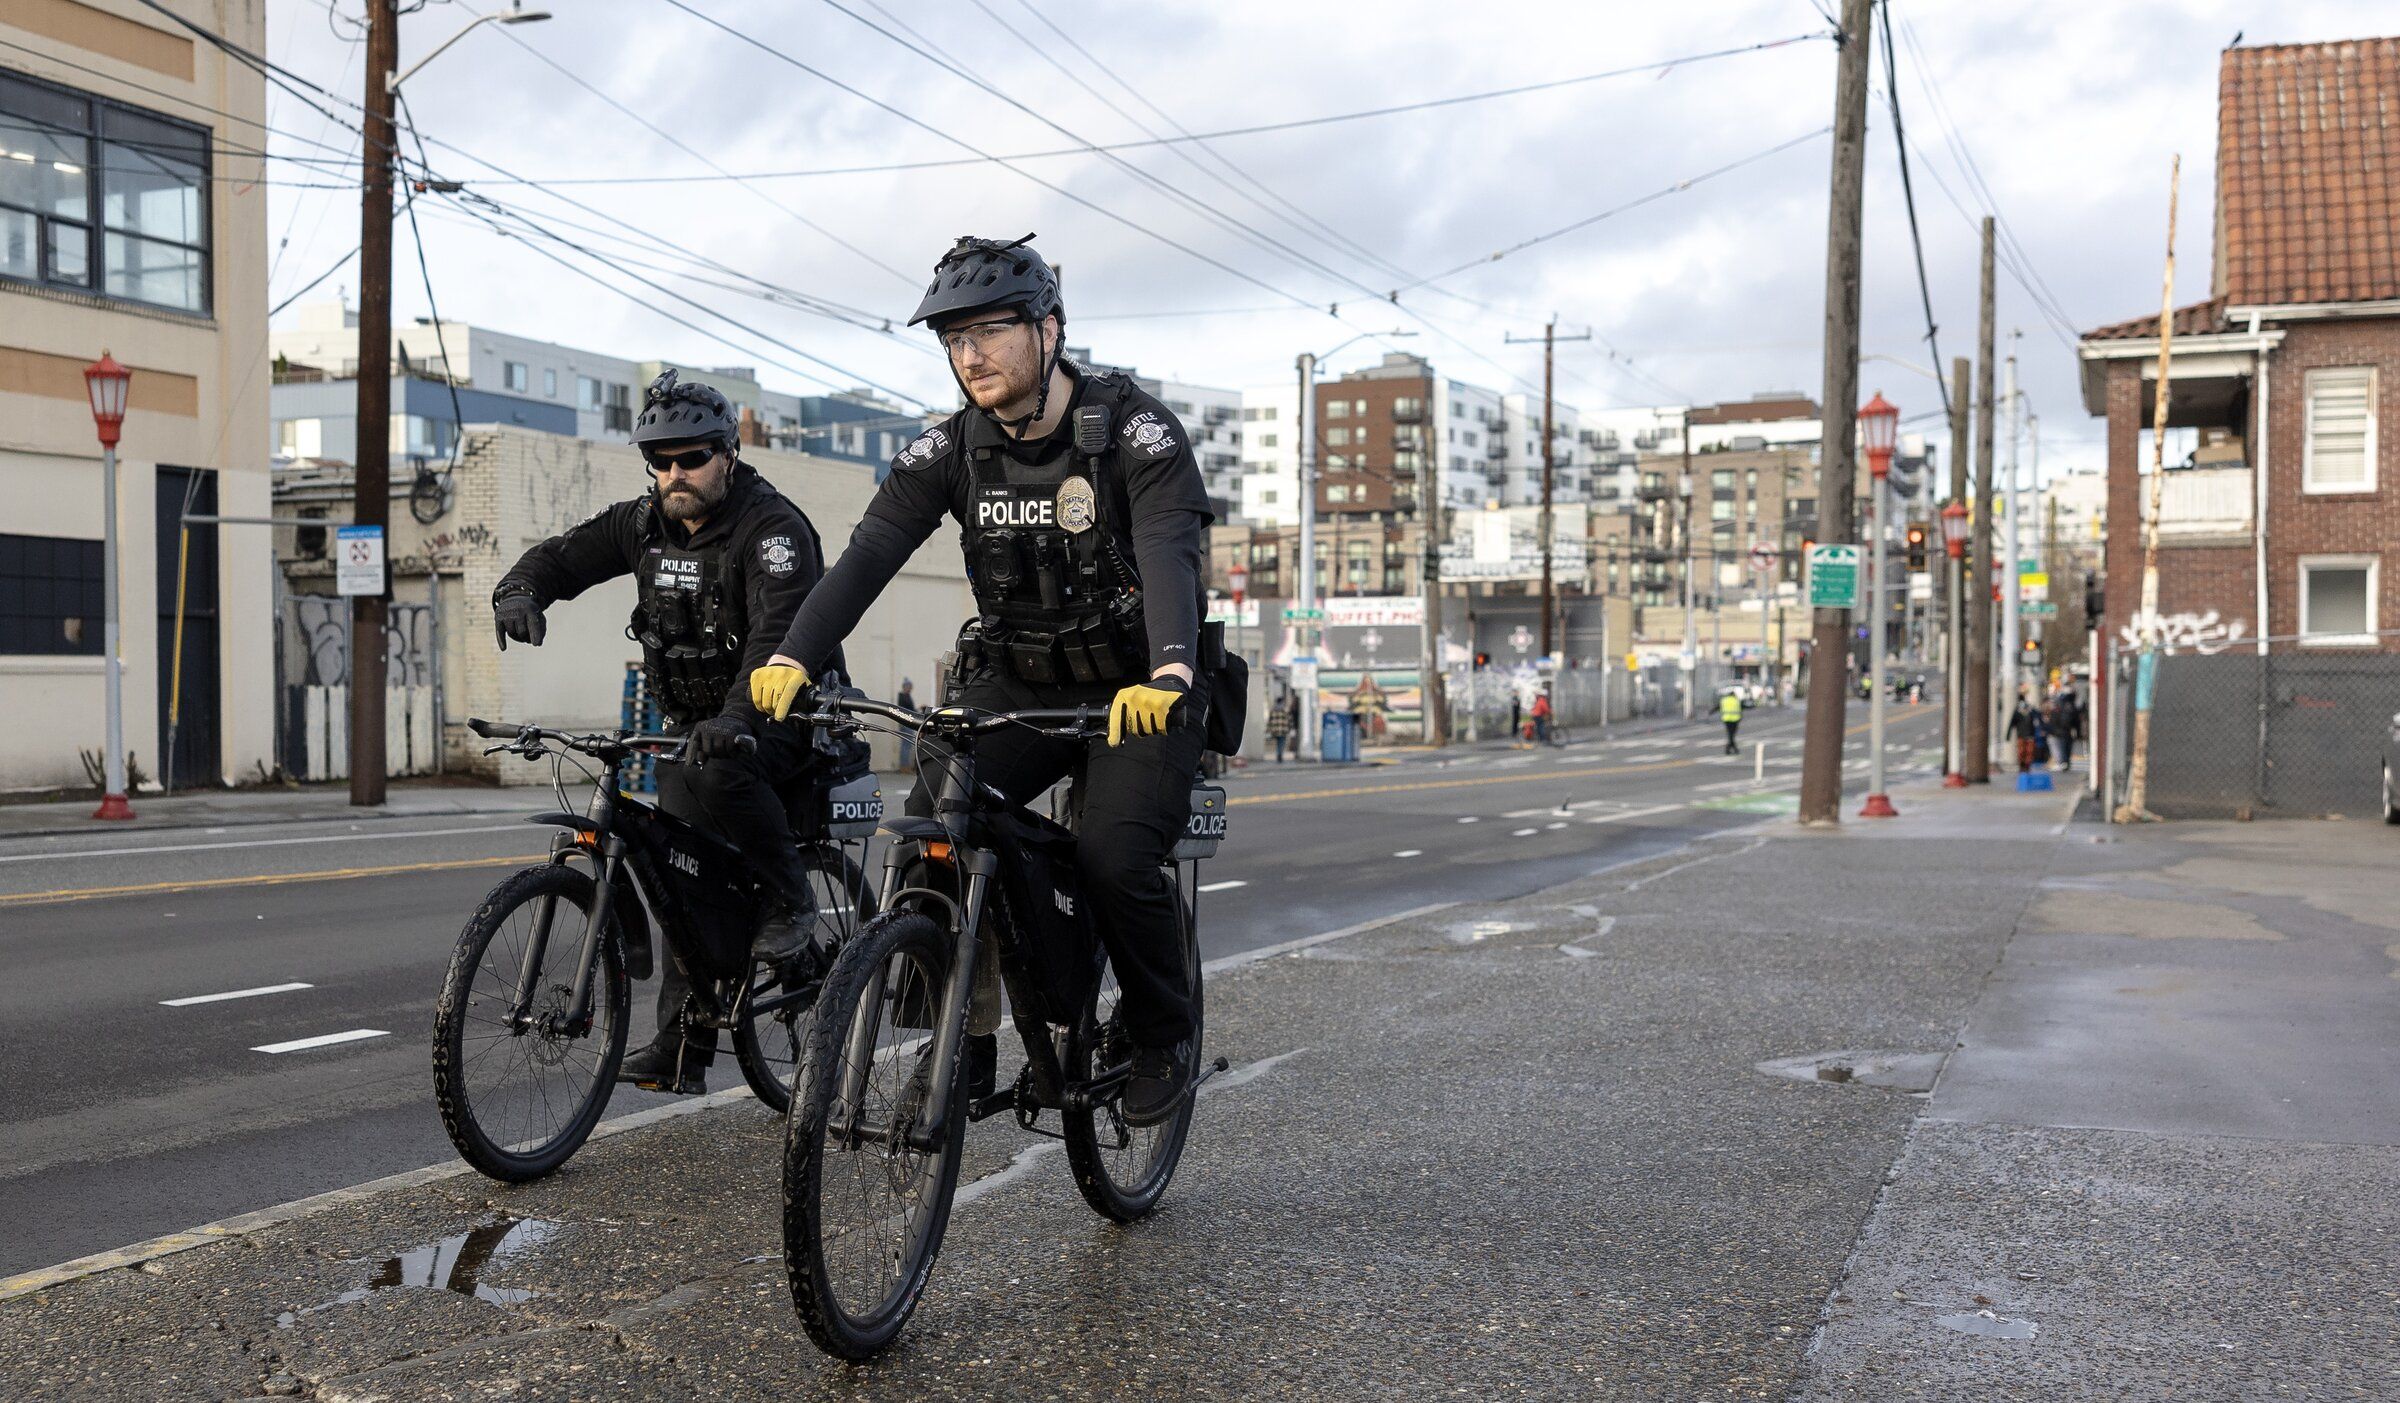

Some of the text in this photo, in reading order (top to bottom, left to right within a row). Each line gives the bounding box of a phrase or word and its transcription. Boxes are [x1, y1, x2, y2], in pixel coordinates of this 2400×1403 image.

[1123, 412, 1158, 437] SEATTLE
[1146, 436, 1176, 456] POLICE
[979, 500, 1053, 526] POLICE
[762, 536, 791, 549] SEATTLE
[661, 558, 698, 574] POLICE
[769, 561, 793, 573] POLICE
[832, 802, 883, 819] POLICE
[668, 847, 699, 877] POLICE
[1146, 1172, 1168, 1199] SERFAS
